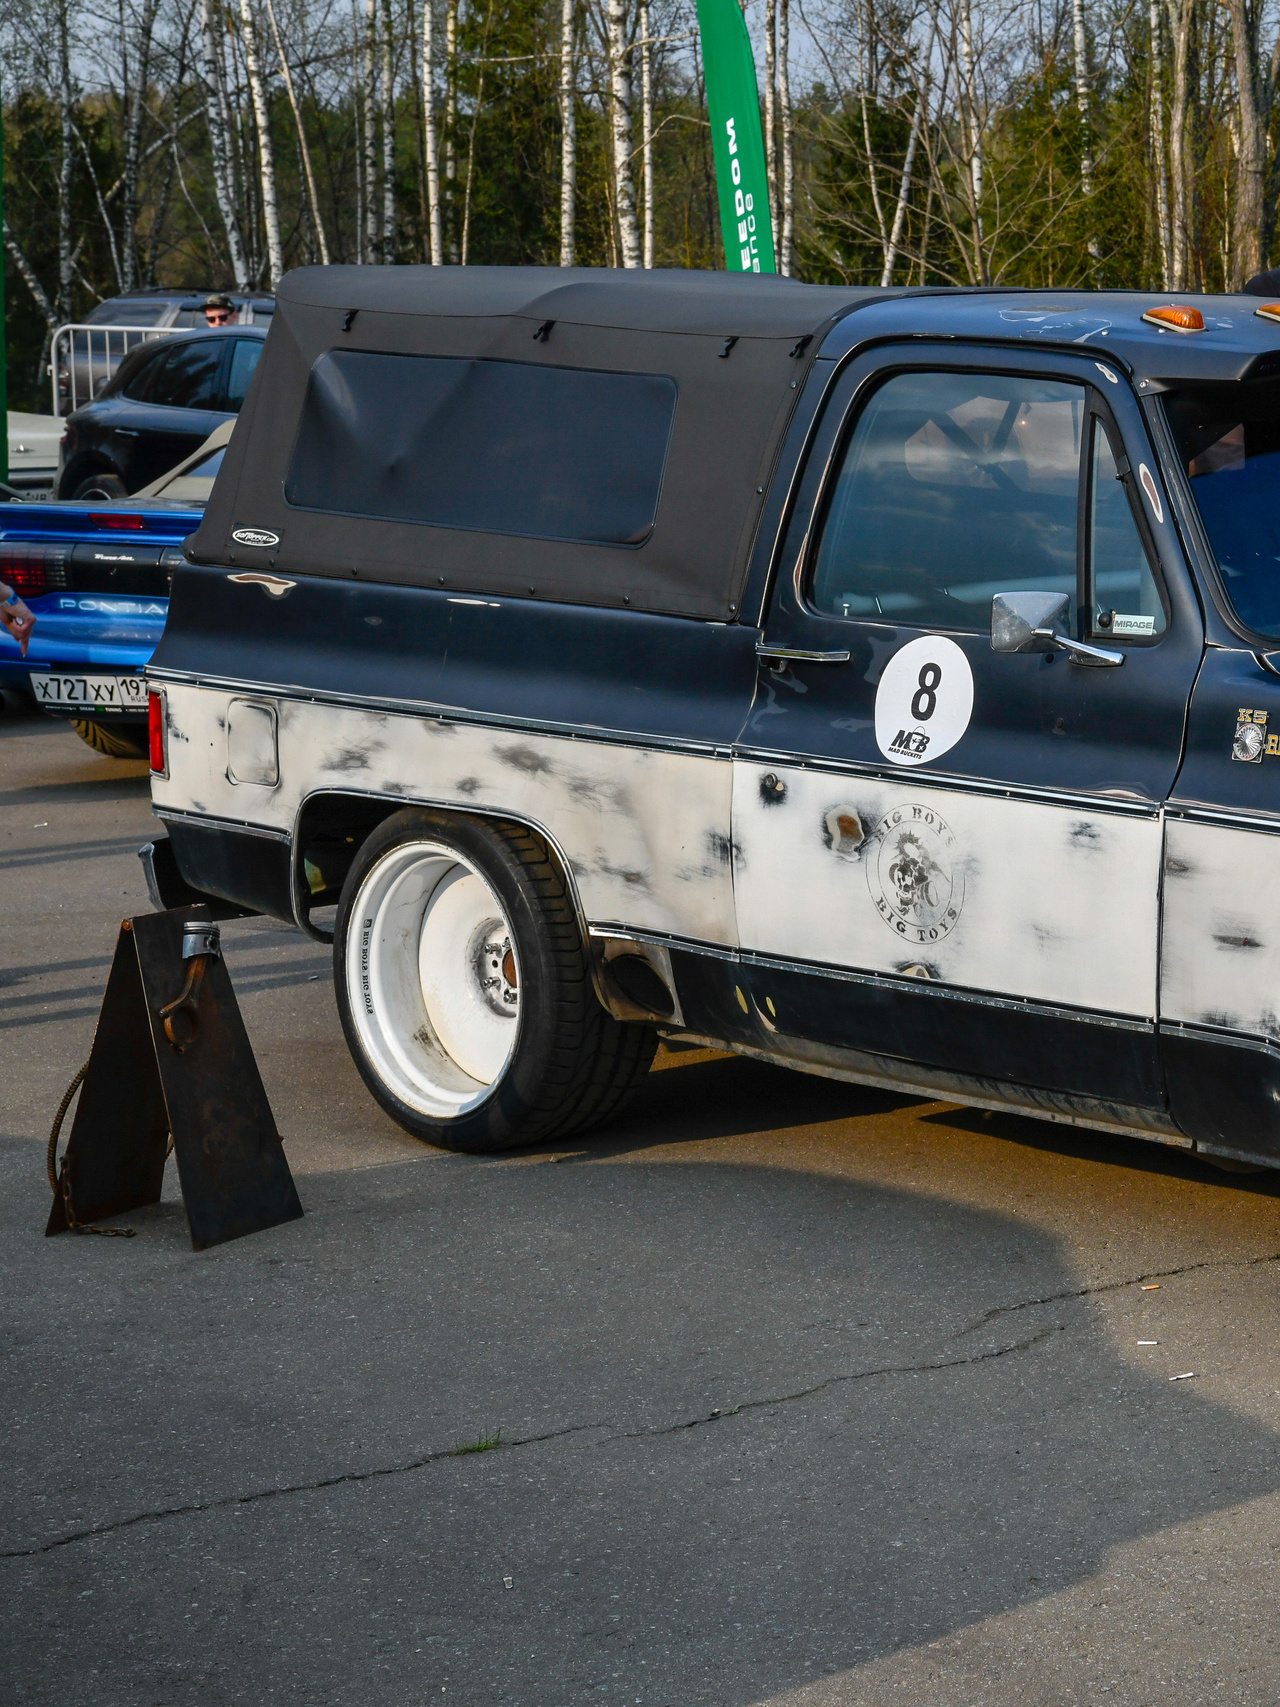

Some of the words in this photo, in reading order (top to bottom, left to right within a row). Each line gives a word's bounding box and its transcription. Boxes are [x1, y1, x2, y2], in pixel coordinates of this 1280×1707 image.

[60, 599, 169, 615] PONTIA
[1114, 620, 1153, 629] MIRAGE
[911, 662, 942, 721] 8
[1237, 708, 1268, 723] K5
[887, 746, 901, 754] MAD
[900, 750, 922, 760] BUCKETS
[876, 896, 907, 934] BIG
[917, 907, 958, 942] TOYS
